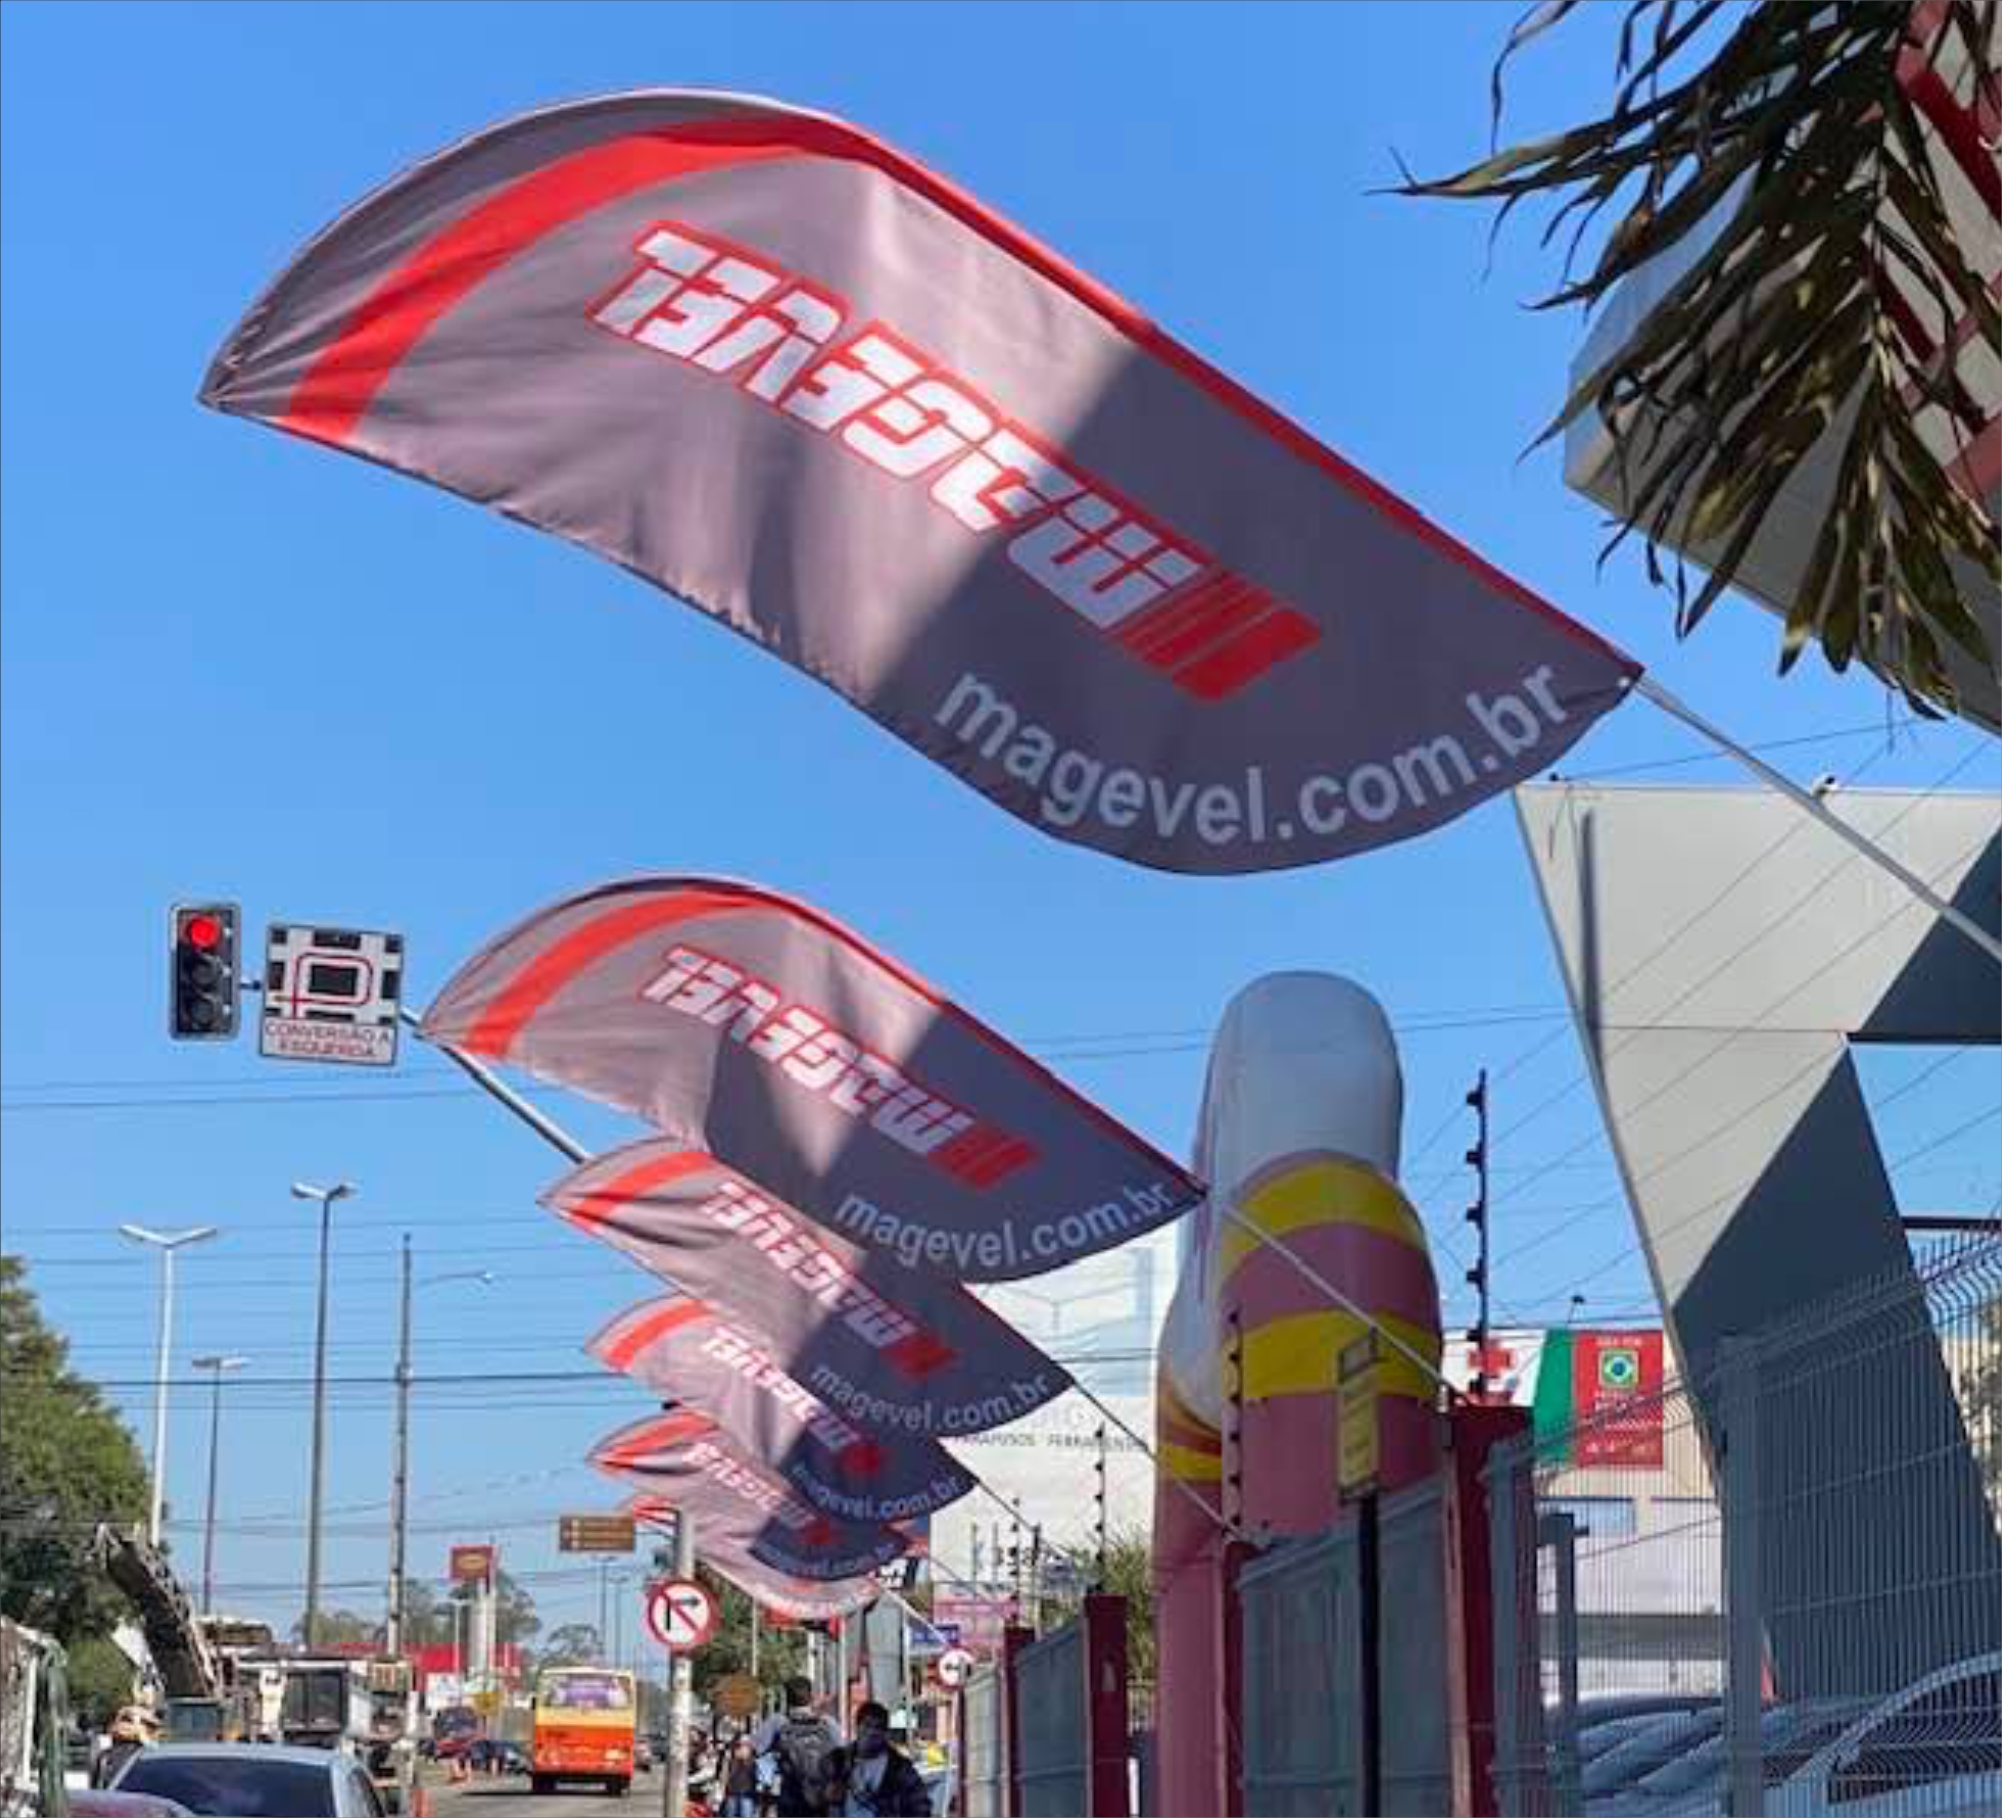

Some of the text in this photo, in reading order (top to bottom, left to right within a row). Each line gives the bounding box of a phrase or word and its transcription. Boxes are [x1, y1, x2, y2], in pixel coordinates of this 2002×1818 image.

[933, 664, 1569, 845] magevel.com.br
[834, 1181, 1174, 1268] magevel.com.br
[810, 1363, 1049, 1430] magevel.com.br
